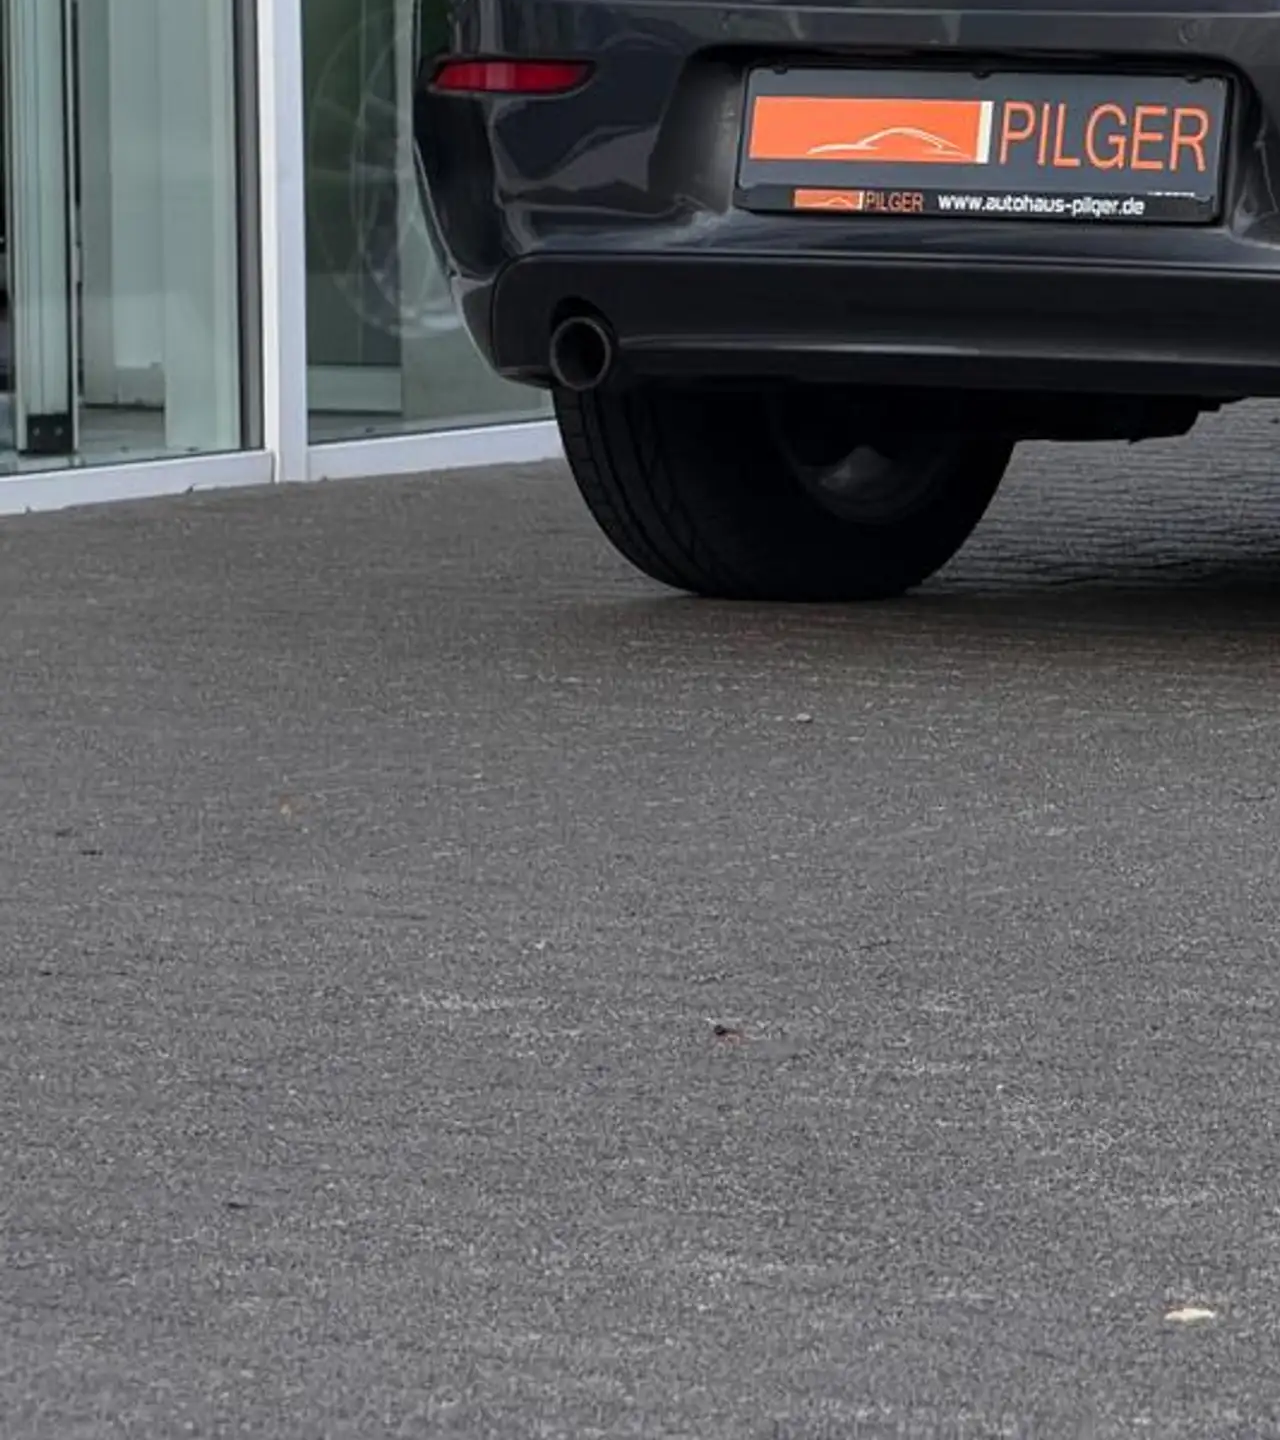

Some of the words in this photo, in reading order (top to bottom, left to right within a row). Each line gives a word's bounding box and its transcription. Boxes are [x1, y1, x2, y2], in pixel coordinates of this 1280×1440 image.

[999, 101, 1210, 172] PILGER
[864, 191, 924, 213] PILGER
[938, 193, 1145, 218] www.autohaus-pilger.de
